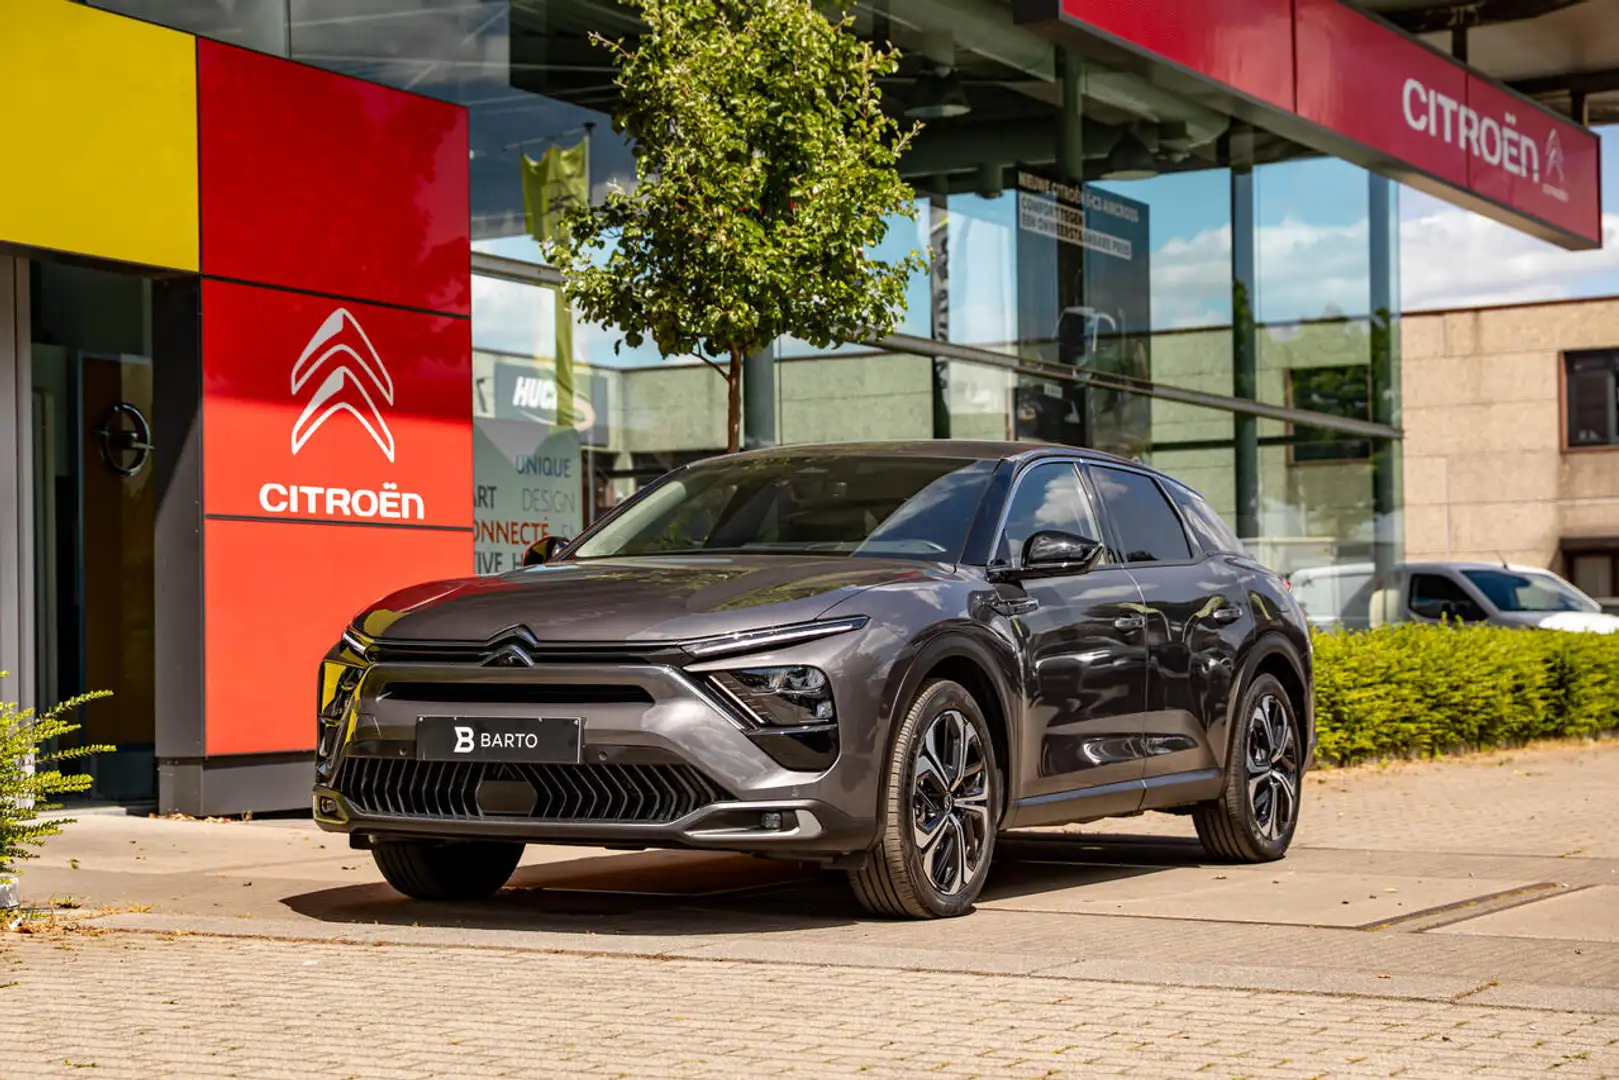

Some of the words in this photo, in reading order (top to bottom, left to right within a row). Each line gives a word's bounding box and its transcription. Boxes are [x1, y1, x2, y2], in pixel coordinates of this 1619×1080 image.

[515, 455, 572, 478] UNIQUE
[522, 487, 576, 513] DESIGN
[480, 733, 538, 749] BARTO
